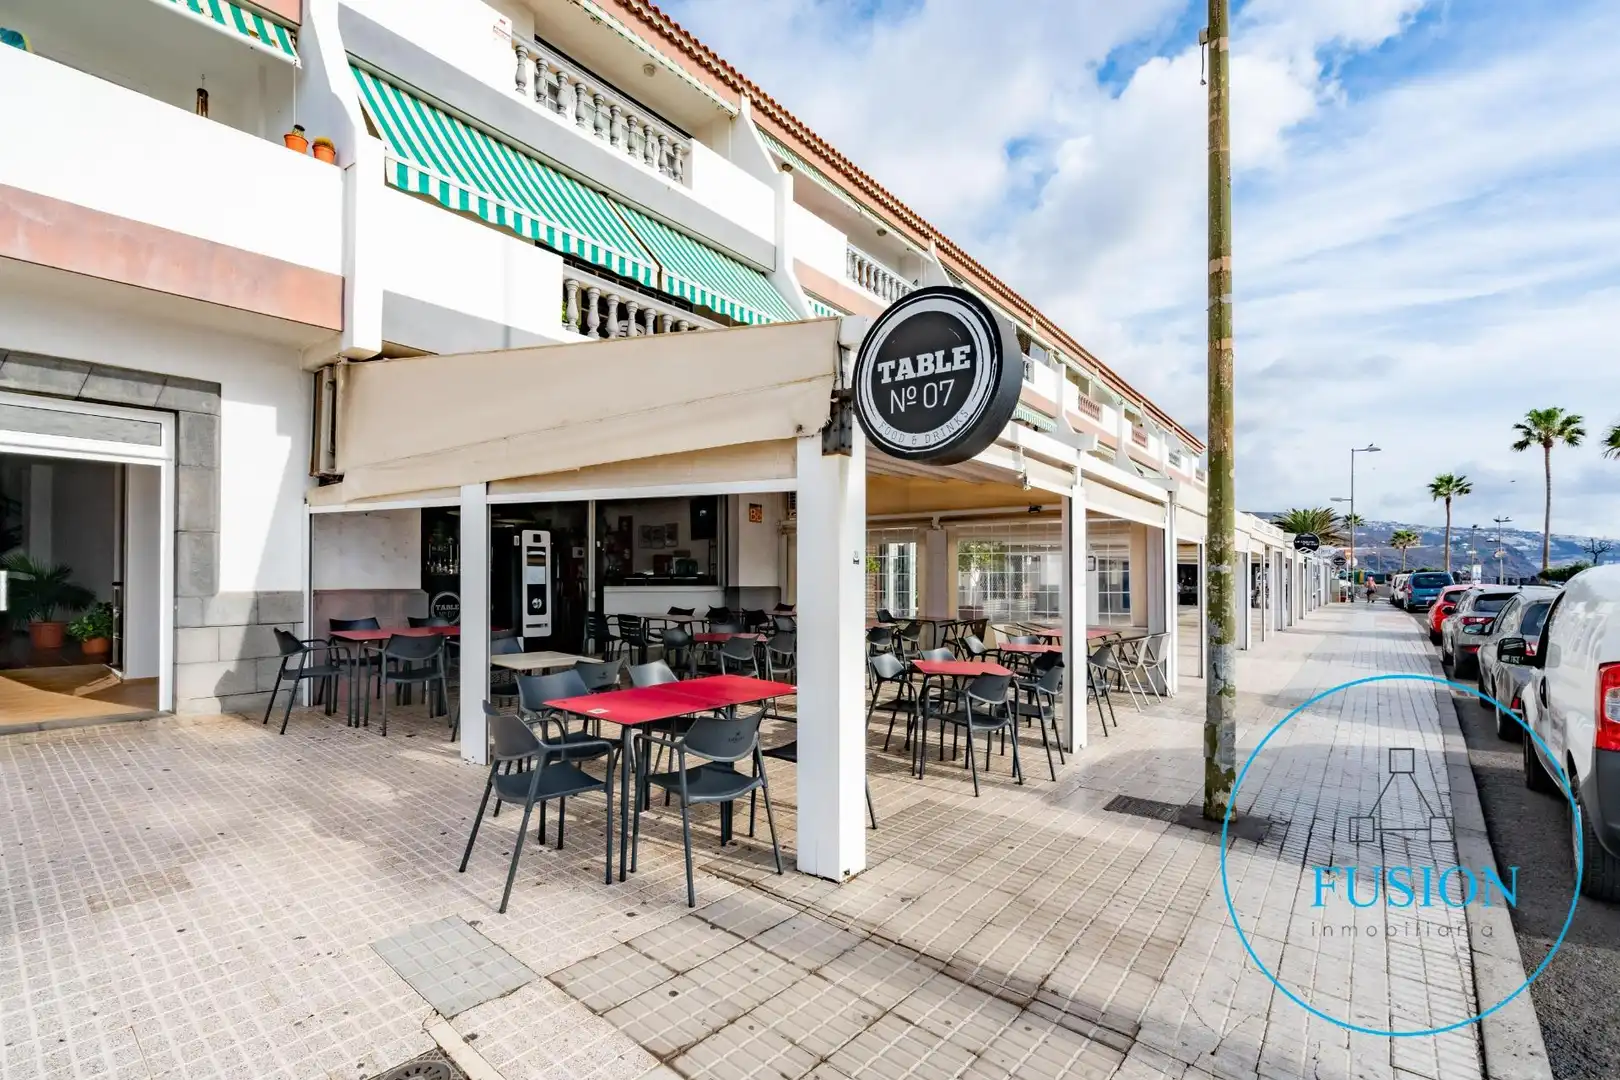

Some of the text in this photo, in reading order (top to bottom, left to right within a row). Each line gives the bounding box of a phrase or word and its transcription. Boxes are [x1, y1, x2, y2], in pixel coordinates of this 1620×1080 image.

[877, 345, 971, 384] TABLE
[923, 379, 955, 409] 07
[878, 409, 970, 446] FOOD & DRINKS
